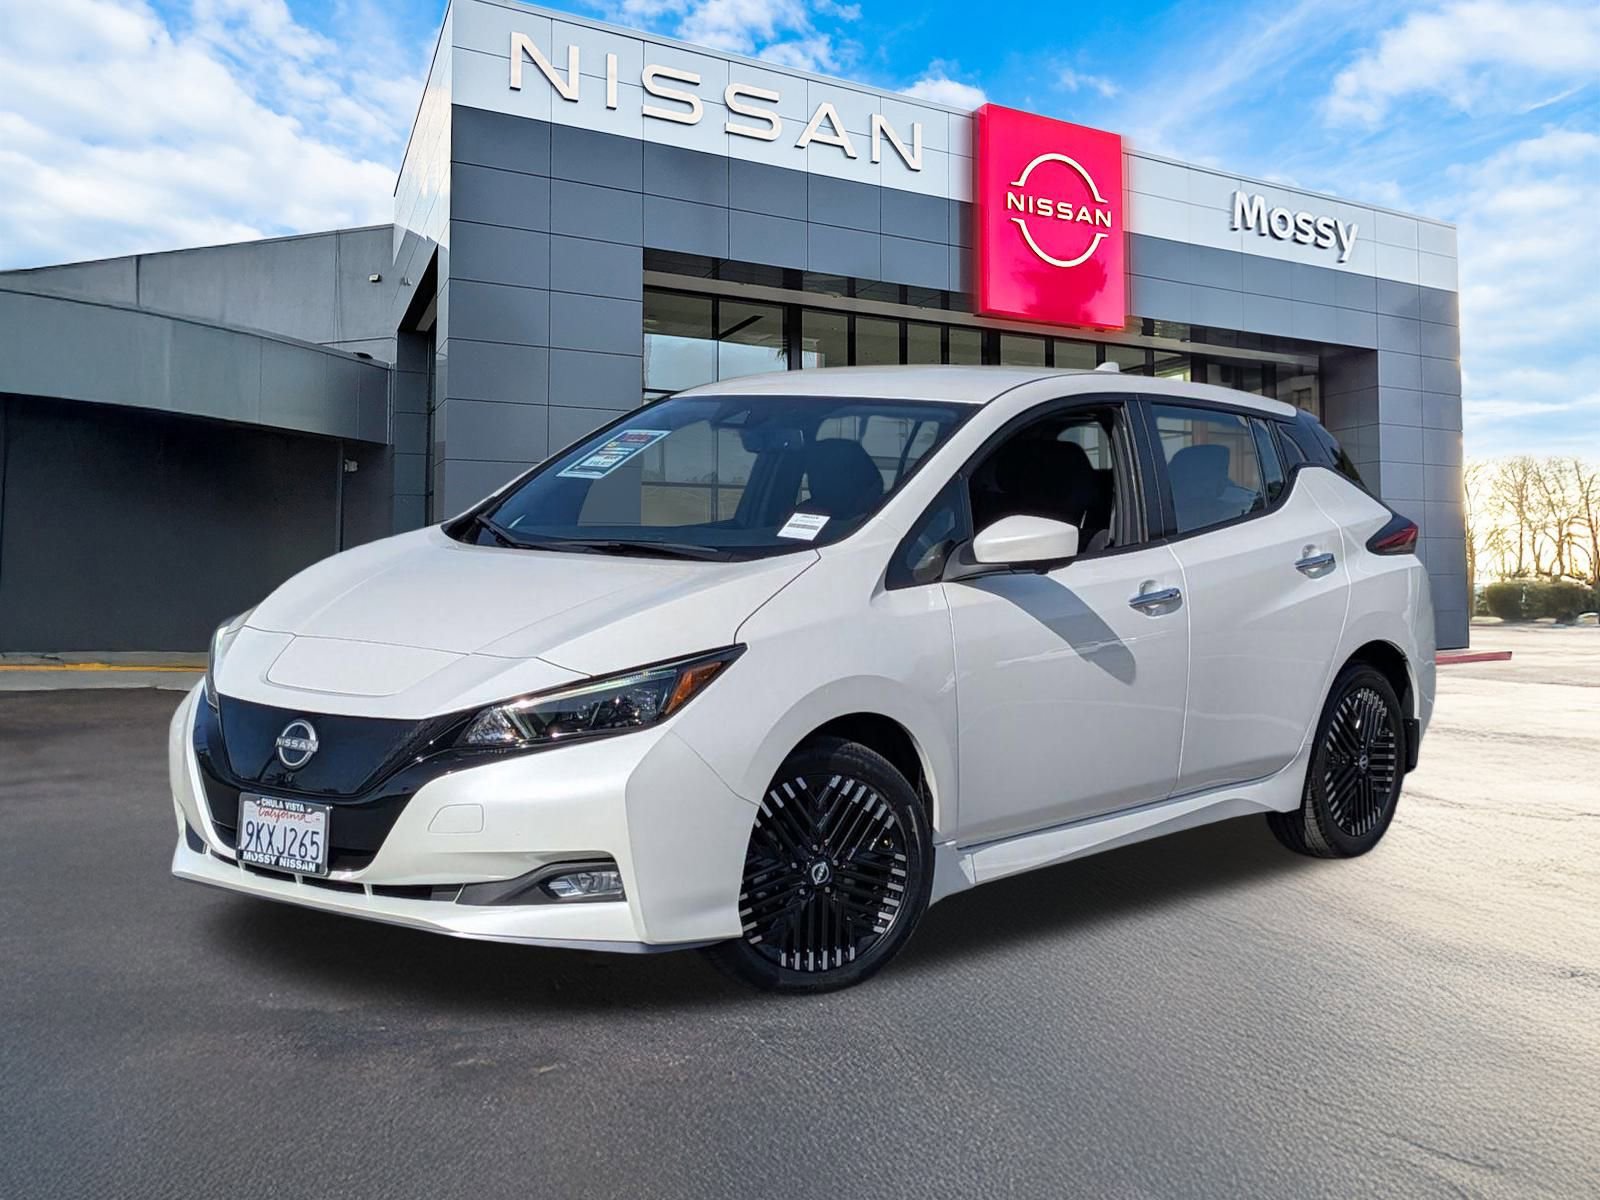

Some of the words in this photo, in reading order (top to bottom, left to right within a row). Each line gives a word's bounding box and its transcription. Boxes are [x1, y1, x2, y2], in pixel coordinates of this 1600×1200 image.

[509, 31, 922, 171] NISSAN
[1005, 190, 1112, 228] NISSAN
[1231, 189, 1360, 263] Mossy
[275, 736, 319, 752] NISSAN
[261, 798, 284, 810] CHULA
[285, 801, 305, 812] VISTA
[244, 820, 320, 860] 9KXJ265
[242, 850, 278, 865] MOSSY
[279, 856, 316, 872] NISSAN
